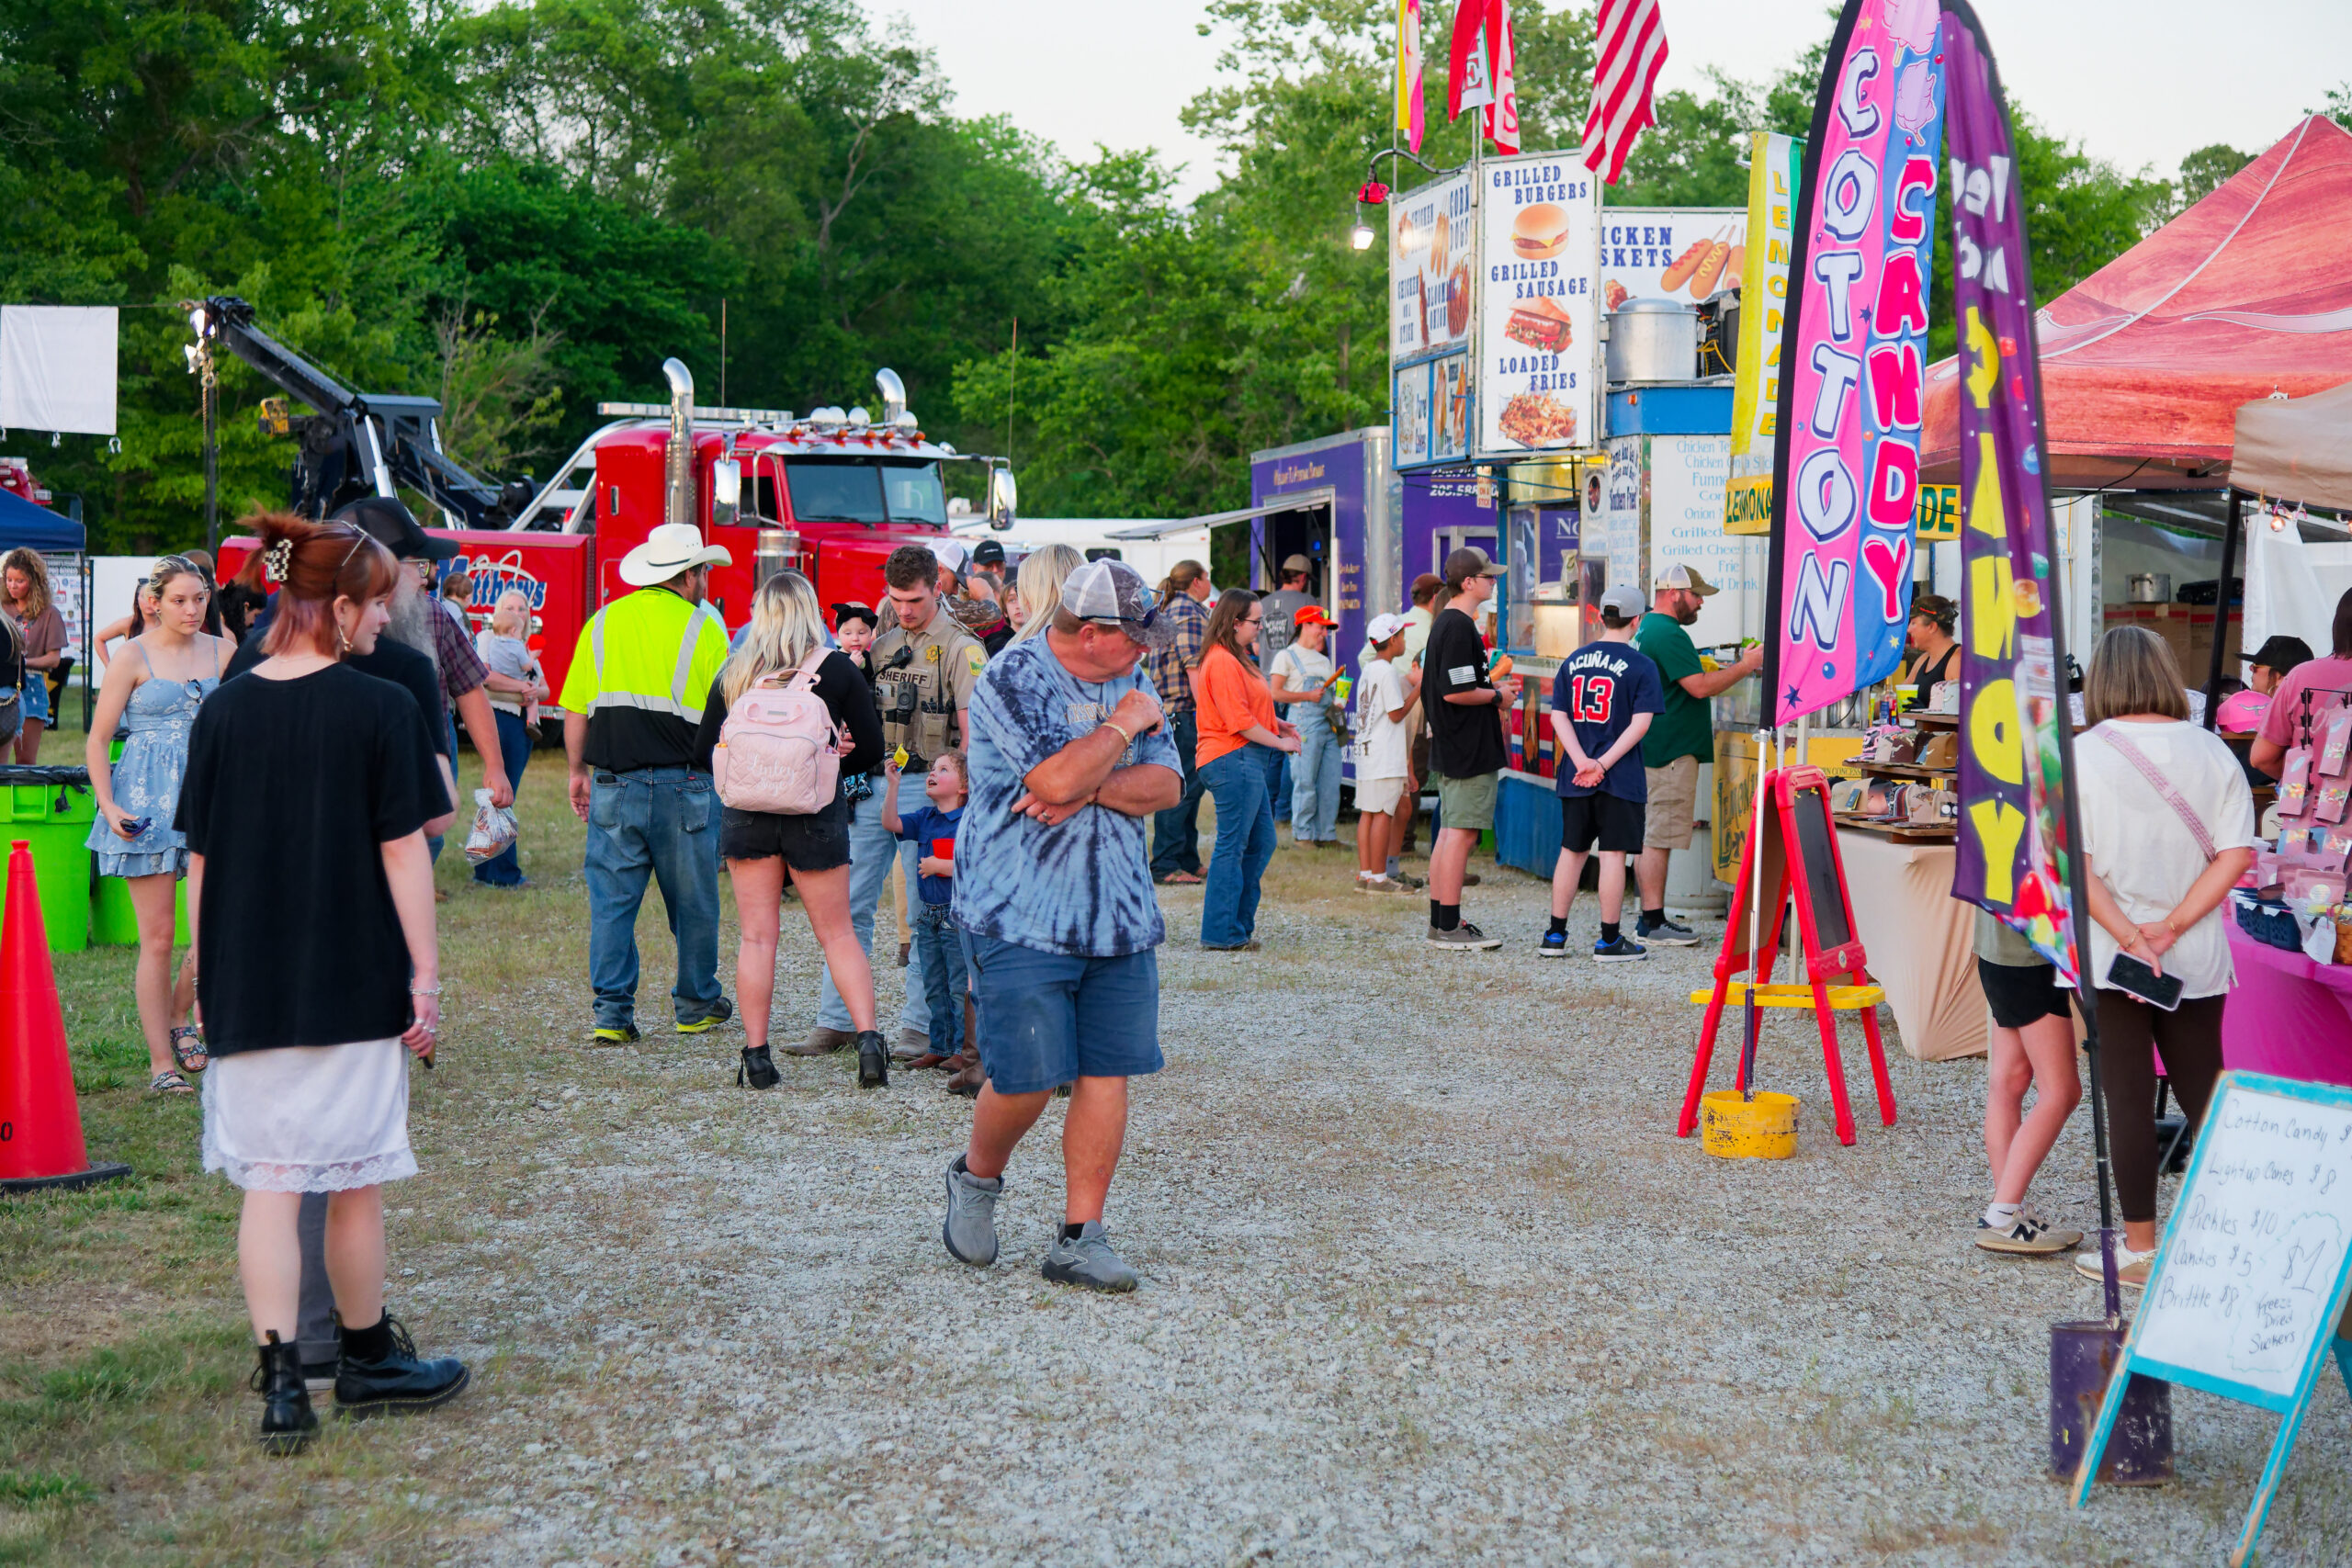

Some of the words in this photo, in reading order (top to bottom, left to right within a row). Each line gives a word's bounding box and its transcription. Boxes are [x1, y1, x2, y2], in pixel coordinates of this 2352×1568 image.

[1493, 165, 1561, 188] GRILLED
[1515, 182, 1587, 205] BURGERS
[1449, 217, 1469, 252] DOGS
[1601, 227, 1672, 245] ICKEN
[1601, 248, 1672, 267] SKETS
[1491, 261, 1559, 282] GRILLED
[1517, 277, 1588, 299] SAUSAGE
[1789, 46, 1883, 653] COTTON
[1499, 355, 1559, 375] LOADED
[1531, 372, 1577, 391] FRIES
[1860, 154, 1938, 627] CANDY
[1677, 440, 1715, 454] Chicken
[1685, 454, 1724, 469] Chicken
[1692, 471, 1727, 486] Funne
[1684, 507, 1715, 520] Onion
[1725, 486, 1772, 524] LEMONA
[1671, 526, 1723, 538] Grilled
[1662, 544, 1702, 556] Grilled
[1568, 650, 1611, 675] ACUÑA
[1608, 658, 1630, 678] JR.
[879, 670, 928, 684] SHERIFF
[1572, 674, 1615, 724] 13
[2223, 1098, 2279, 1134] Cotton
[2285, 1118, 2328, 1152] Candy
[2188, 1194, 2238, 1235] Pickles
[2251, 1208, 2278, 1237] $10
[2174, 1239, 2217, 1268] Candies
[2281, 1237, 2327, 1294] $1
[2159, 1275, 2211, 1310] Brittle
[2265, 1310, 2293, 1329] Dried
[2248, 1331, 2295, 1354] Suckers
